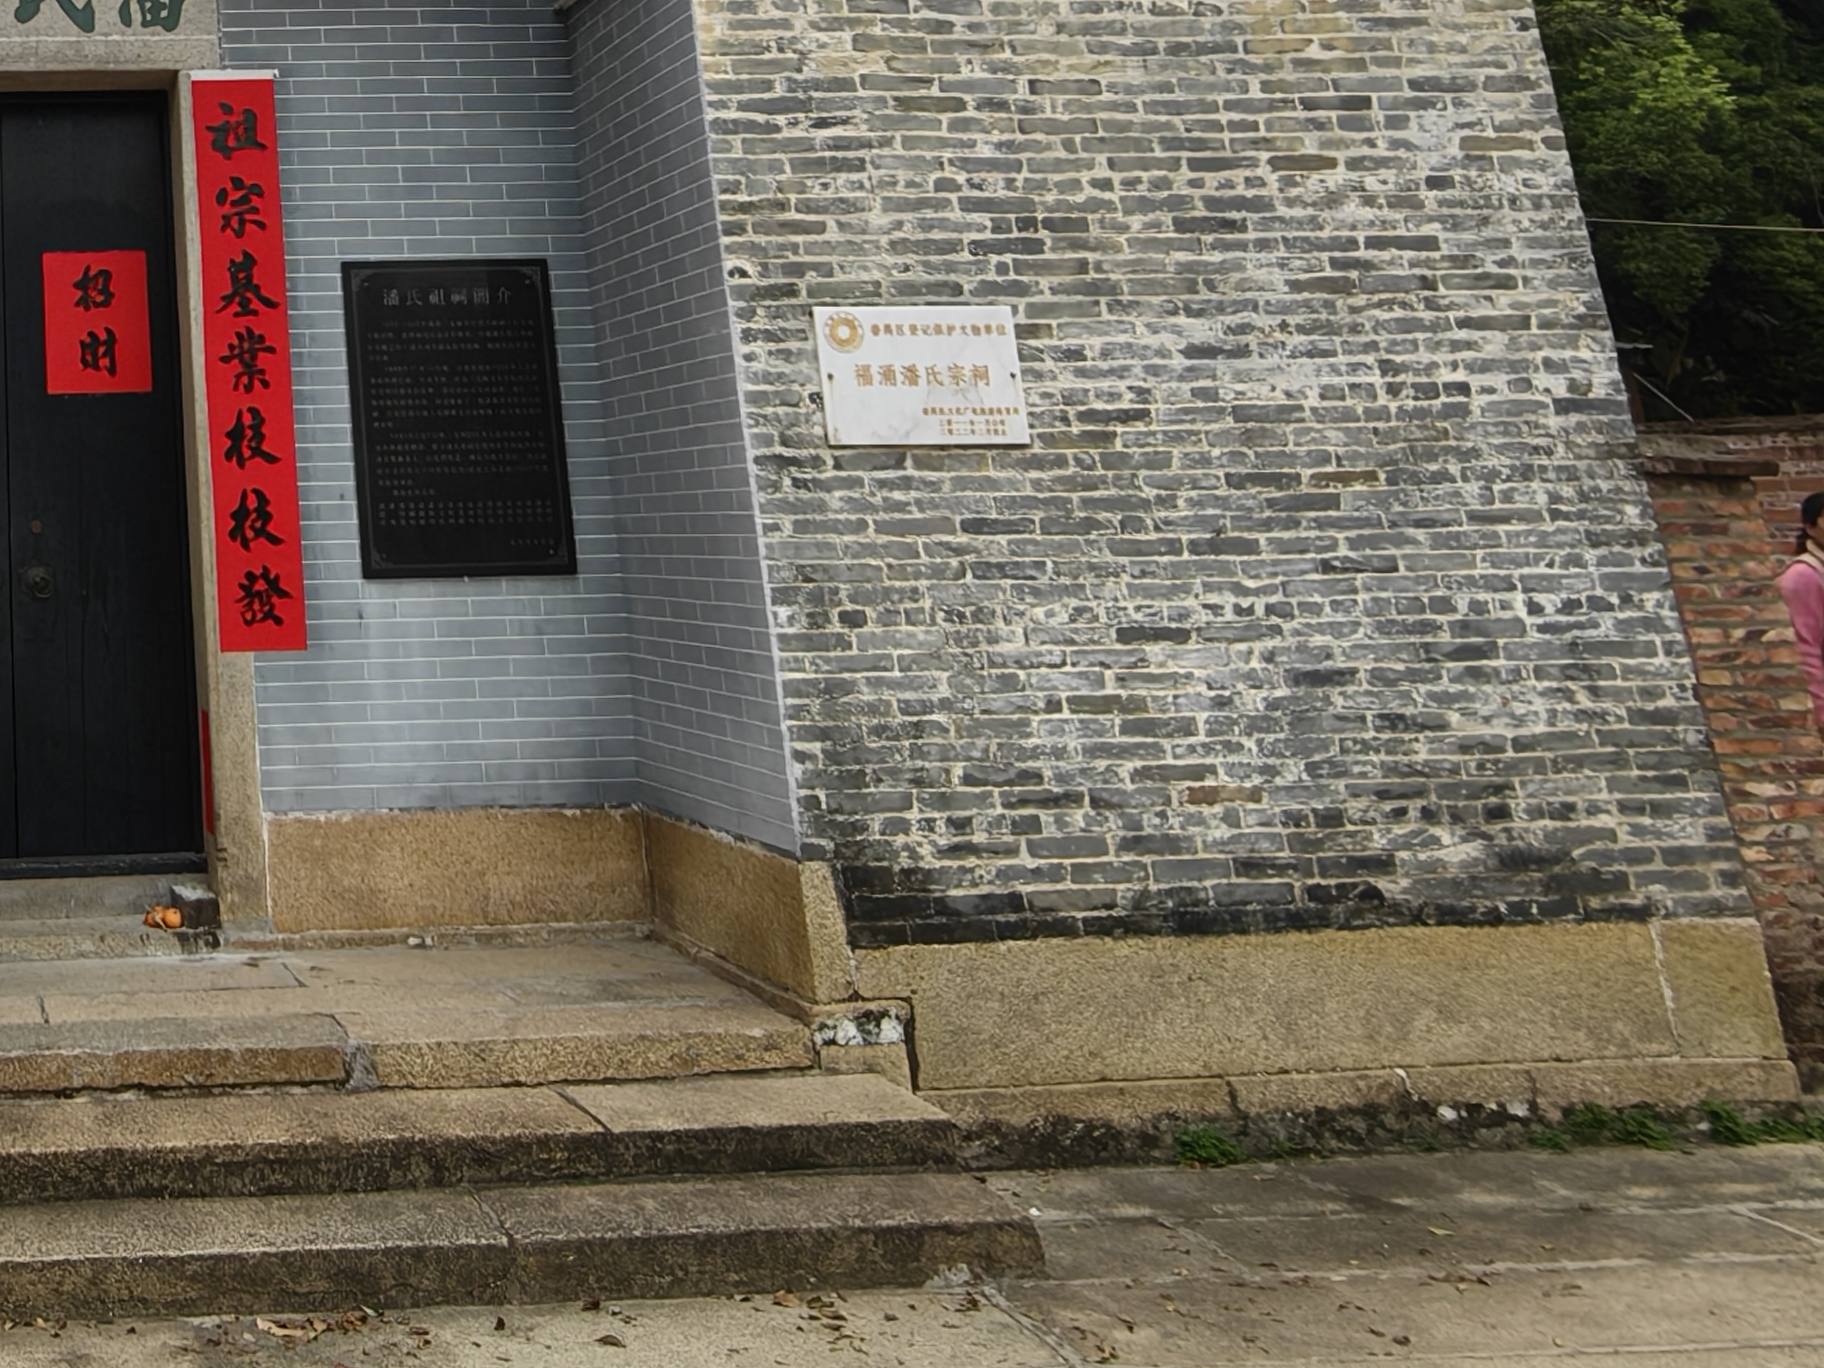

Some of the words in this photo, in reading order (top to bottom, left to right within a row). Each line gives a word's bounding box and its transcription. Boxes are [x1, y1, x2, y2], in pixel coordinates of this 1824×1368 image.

[72, 264, 117, 378] 招財
[205, 102, 294, 628] 祖宗基業枝枝發
